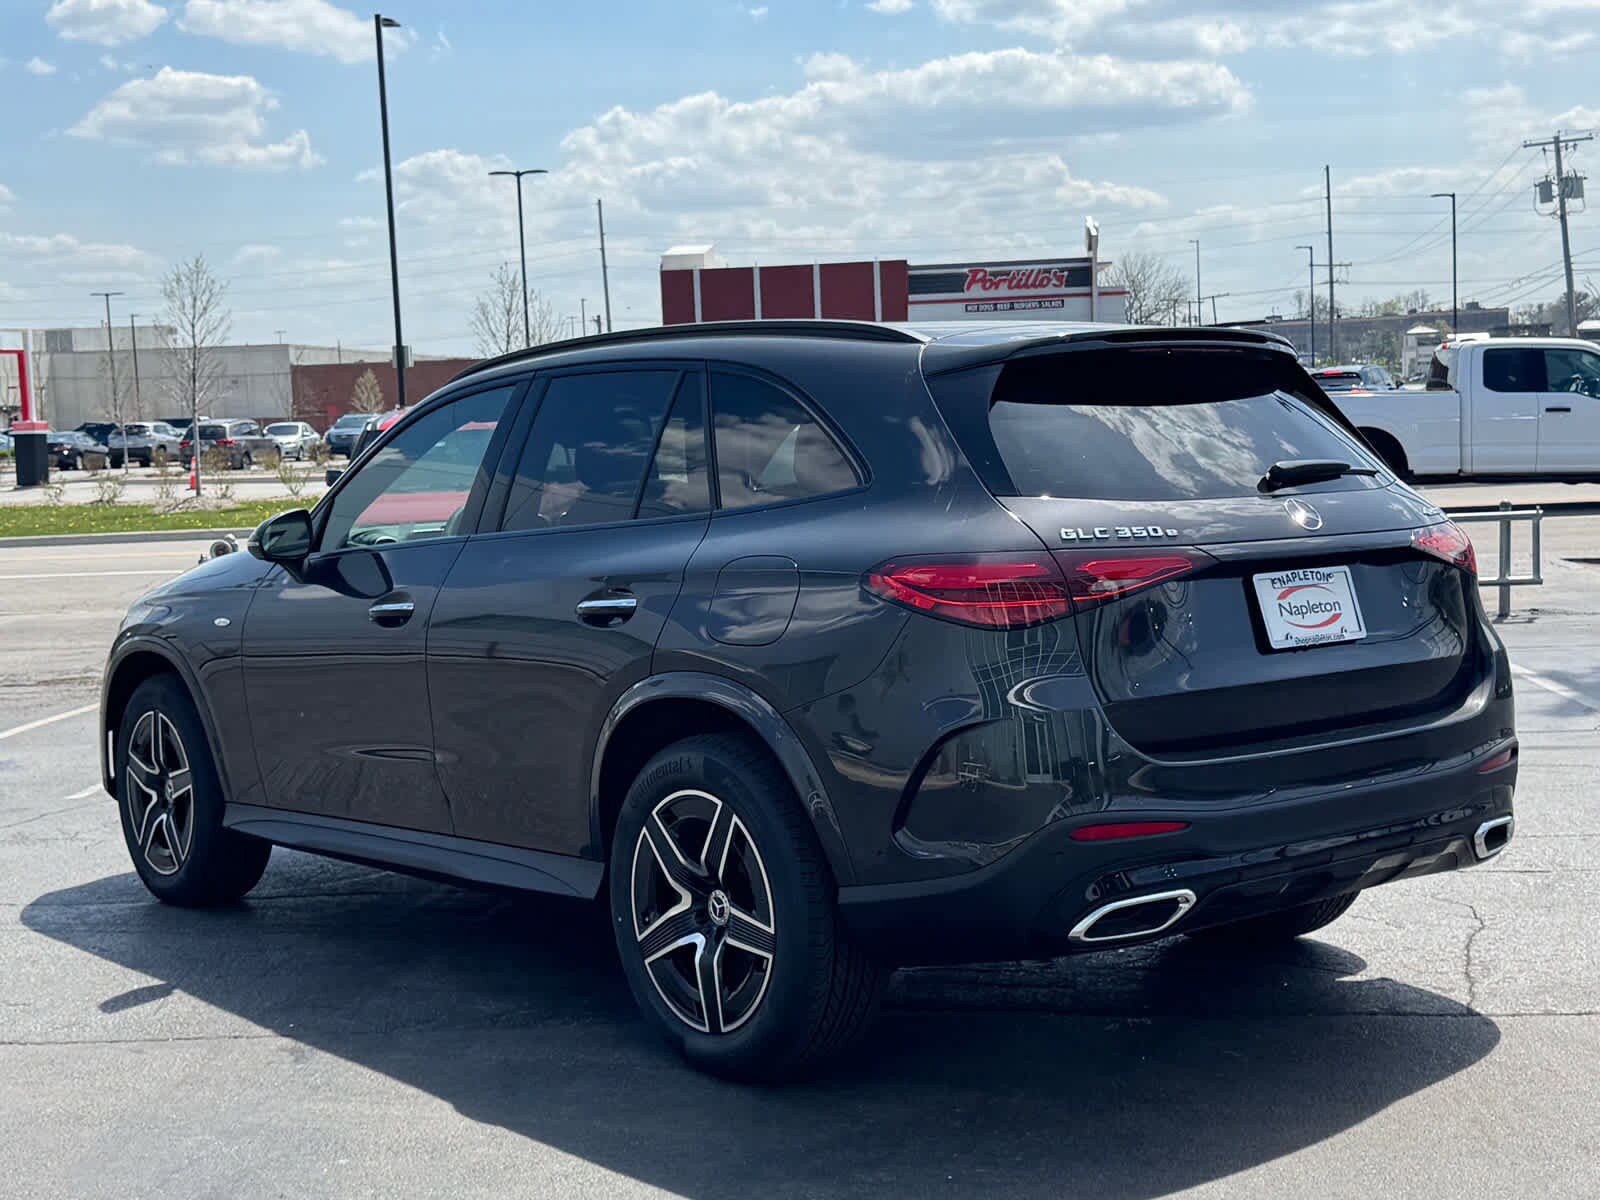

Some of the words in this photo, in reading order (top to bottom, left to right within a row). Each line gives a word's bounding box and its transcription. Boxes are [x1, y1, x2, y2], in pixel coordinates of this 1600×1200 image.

[964, 268, 1067, 292] Portillo's
[1060, 527, 1110, 540] GLC
[1278, 600, 1342, 619] Napleton
